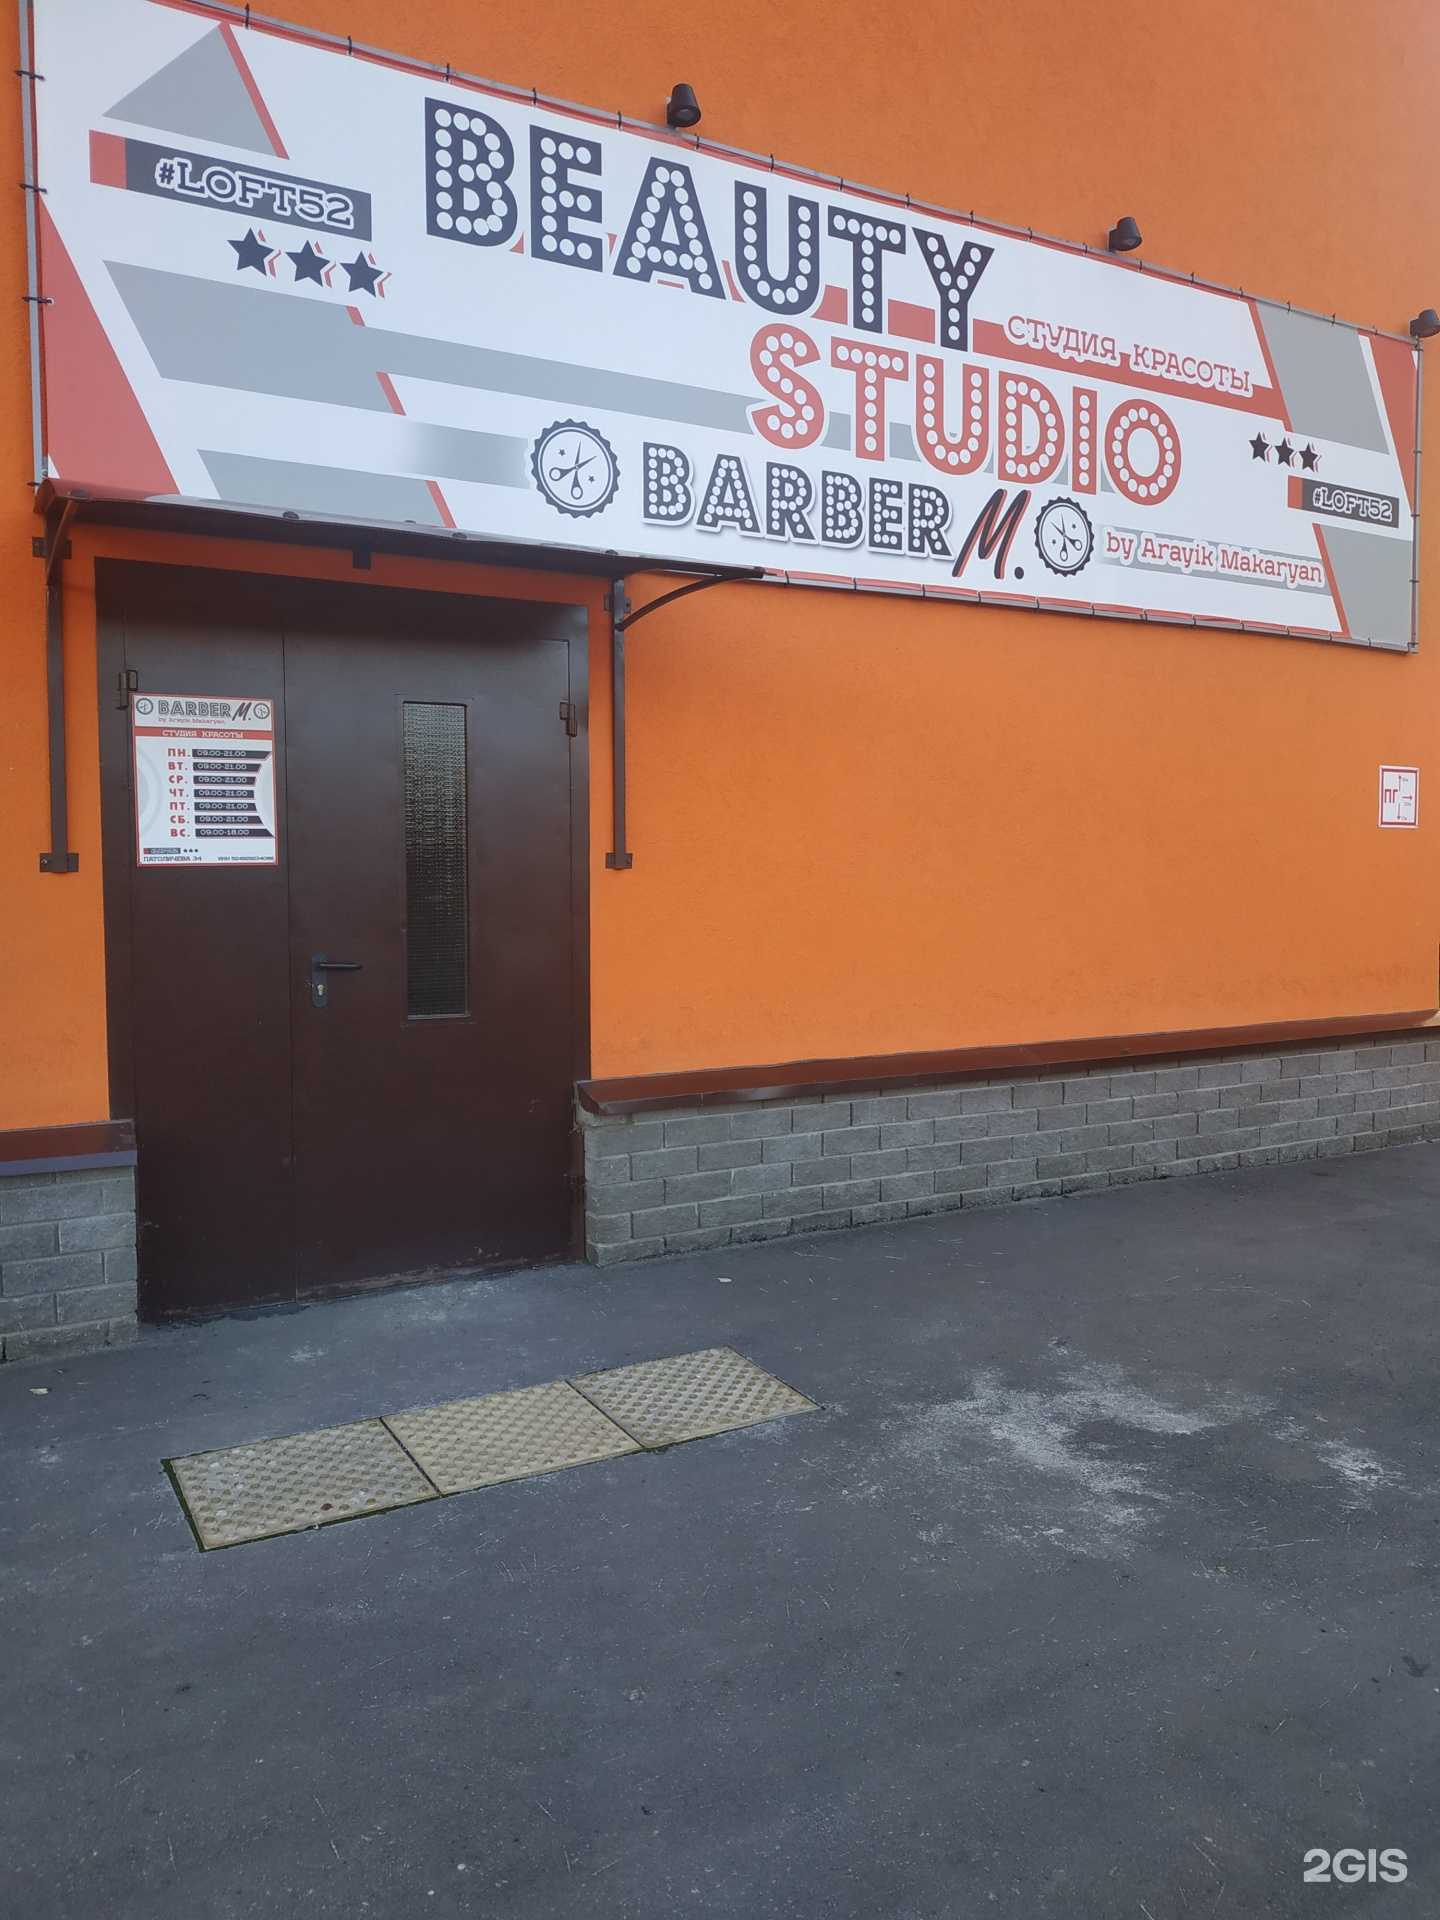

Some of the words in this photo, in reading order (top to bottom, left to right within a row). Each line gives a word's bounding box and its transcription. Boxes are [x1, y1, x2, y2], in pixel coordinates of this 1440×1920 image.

[155, 157, 354, 229] #LOFT52
[425, 97, 995, 351] BEAUTY
[1007, 316, 1116, 363] СТУДИЯ
[1134, 344, 1251, 394] КРАСОТЫ
[750, 323, 1181, 506] STUDIO
[1313, 486, 1393, 521] #LOFT52
[1106, 530, 1132, 559] by
[1142, 538, 1214, 570] Arayik
[1221, 548, 1323, 584] Makaryan
[201, 731, 243, 739] КРАСОТЫ
[168, 748, 190, 757] ПН.
[168, 762, 188, 770] ВТ.
[168, 775, 188, 784] СР.
[169, 788, 189, 797] ЧТ.
[170, 802, 190, 810] ПТ.
[170, 815, 190, 824] СБ.
[170, 829, 191, 837] ВС.
